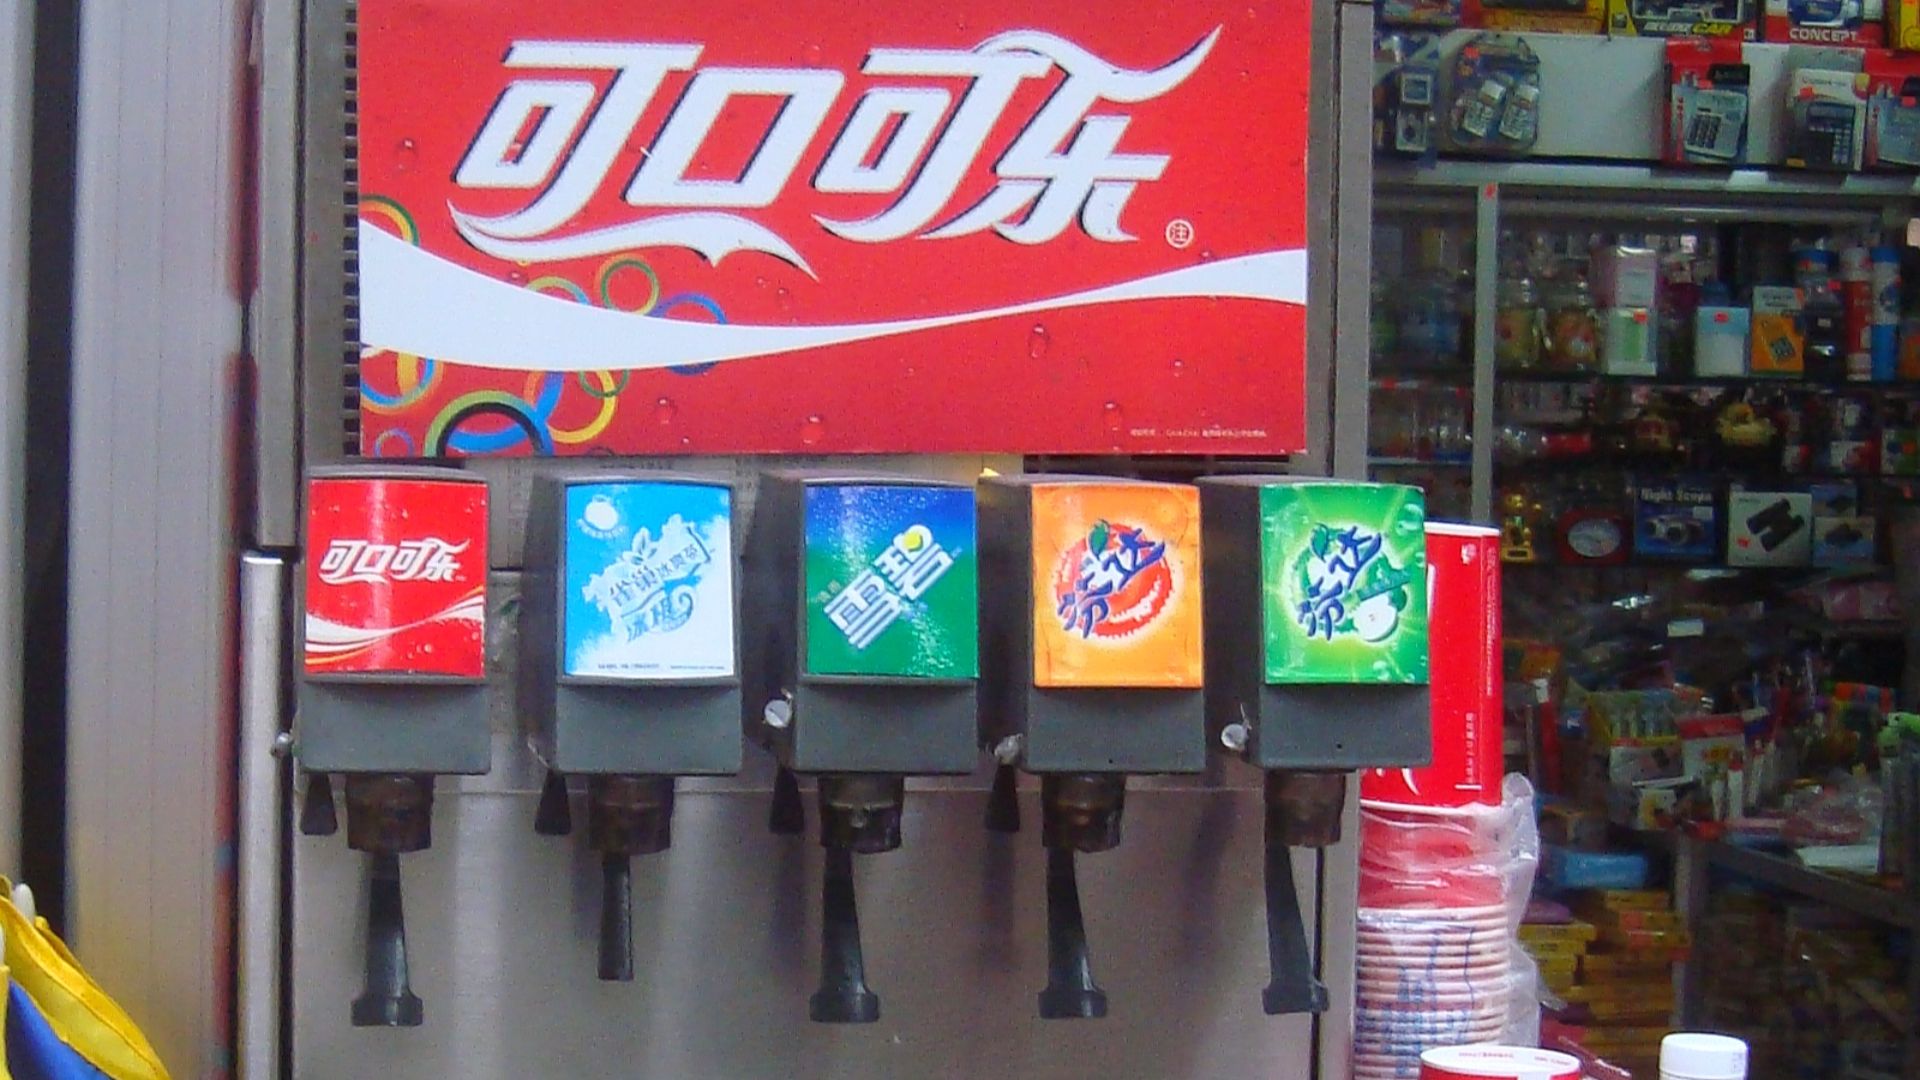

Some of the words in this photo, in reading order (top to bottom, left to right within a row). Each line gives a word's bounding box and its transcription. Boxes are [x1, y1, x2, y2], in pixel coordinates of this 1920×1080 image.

[1789, 27, 1859, 43] CONCEPT
[446, 24, 1223, 281] 可口可乐
[318, 536, 472, 587] 可口可乐
[824, 524, 954, 649] 雪碧
[1057, 520, 1166, 640] 芬达
[1298, 523, 1382, 641] 芬达
